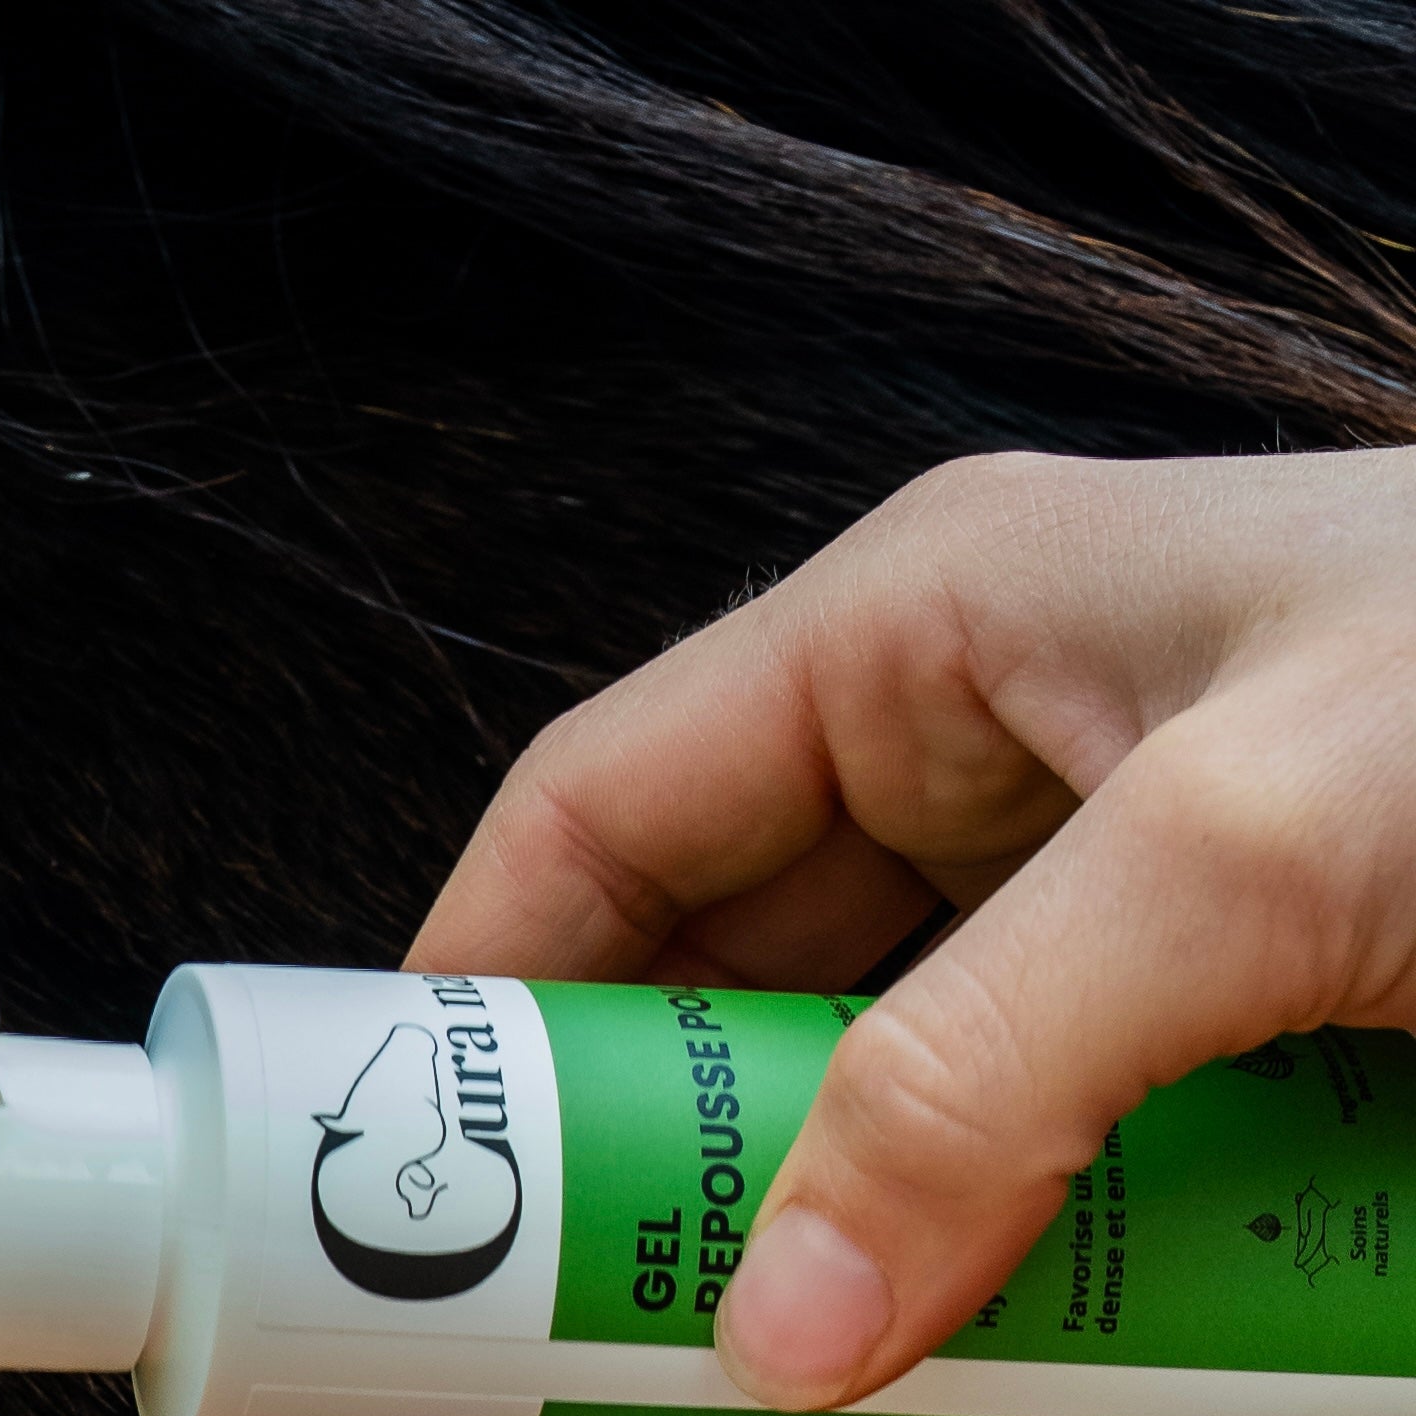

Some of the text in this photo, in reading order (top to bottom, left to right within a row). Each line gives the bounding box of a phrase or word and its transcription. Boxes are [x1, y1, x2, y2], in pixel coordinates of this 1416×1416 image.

[311, 1021, 522, 1301] Cura
[686, 1040, 745, 1313] REPOUSSE
[1106, 1167, 1126, 1200] en
[632, 1207, 682, 1312] GEL
[1105, 1208, 1126, 1239] et
[1350, 1206, 1367, 1260] Soins
[1372, 1191, 1389, 1276] naturels
[1062, 1210, 1094, 1332] Favorise
[1095, 1247, 1125, 1334] dense
